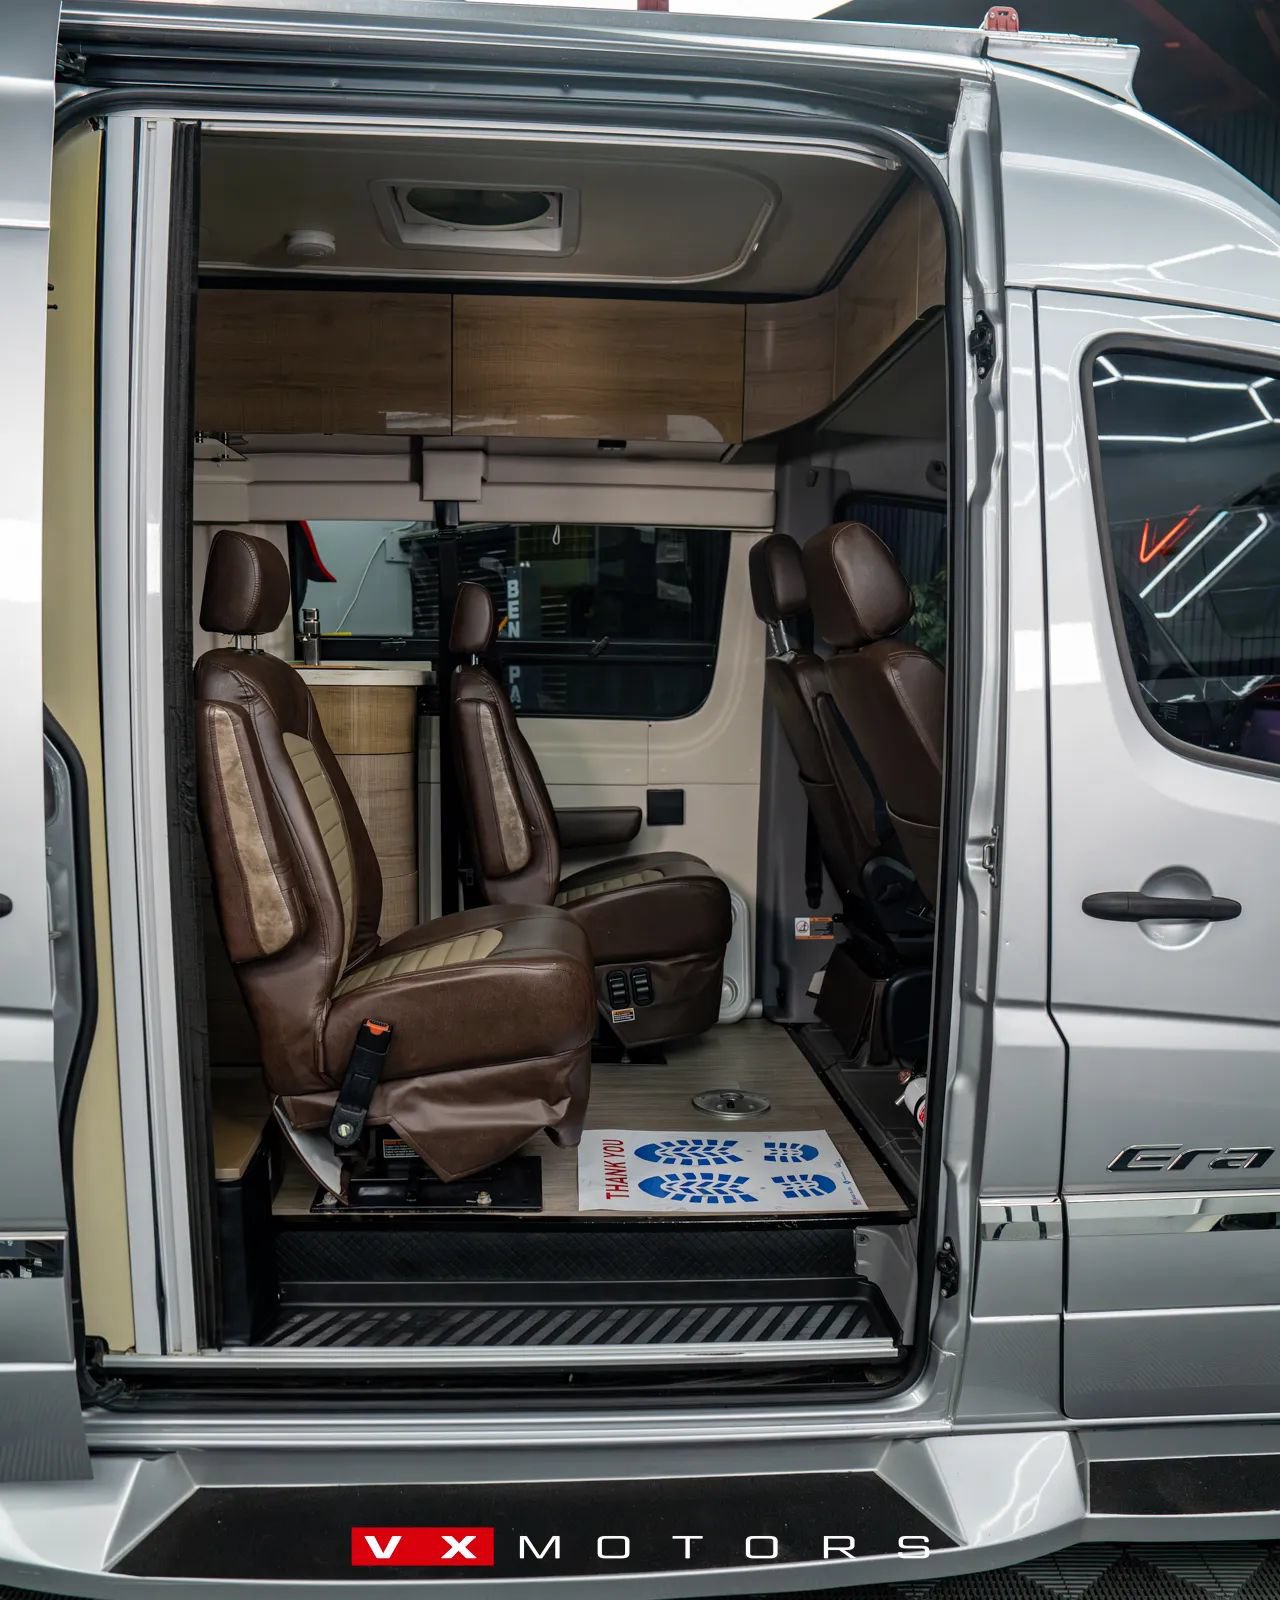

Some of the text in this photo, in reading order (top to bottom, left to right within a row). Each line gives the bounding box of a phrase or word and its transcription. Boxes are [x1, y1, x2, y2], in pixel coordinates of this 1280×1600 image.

[602, 1139, 630, 1200] THANK YOU
[1106, 1143, 1275, 1172] Era
